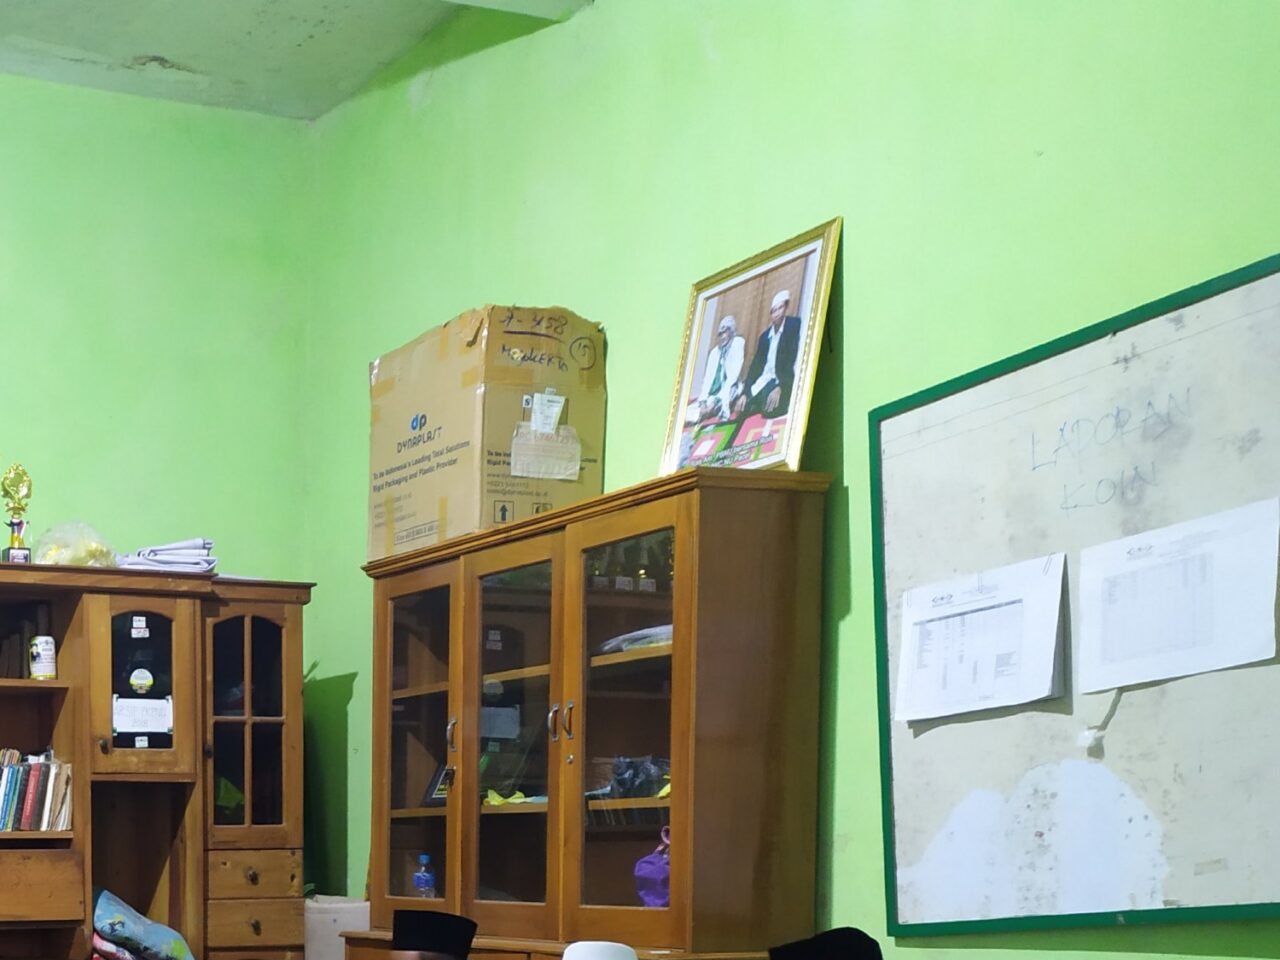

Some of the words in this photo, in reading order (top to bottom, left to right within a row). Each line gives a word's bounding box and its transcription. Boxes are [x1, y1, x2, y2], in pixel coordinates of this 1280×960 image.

[397, 426, 442, 453] DYNAPLAST
[1031, 387, 1191, 474] LAPORAN
[1060, 461, 1158, 518] KOIN
